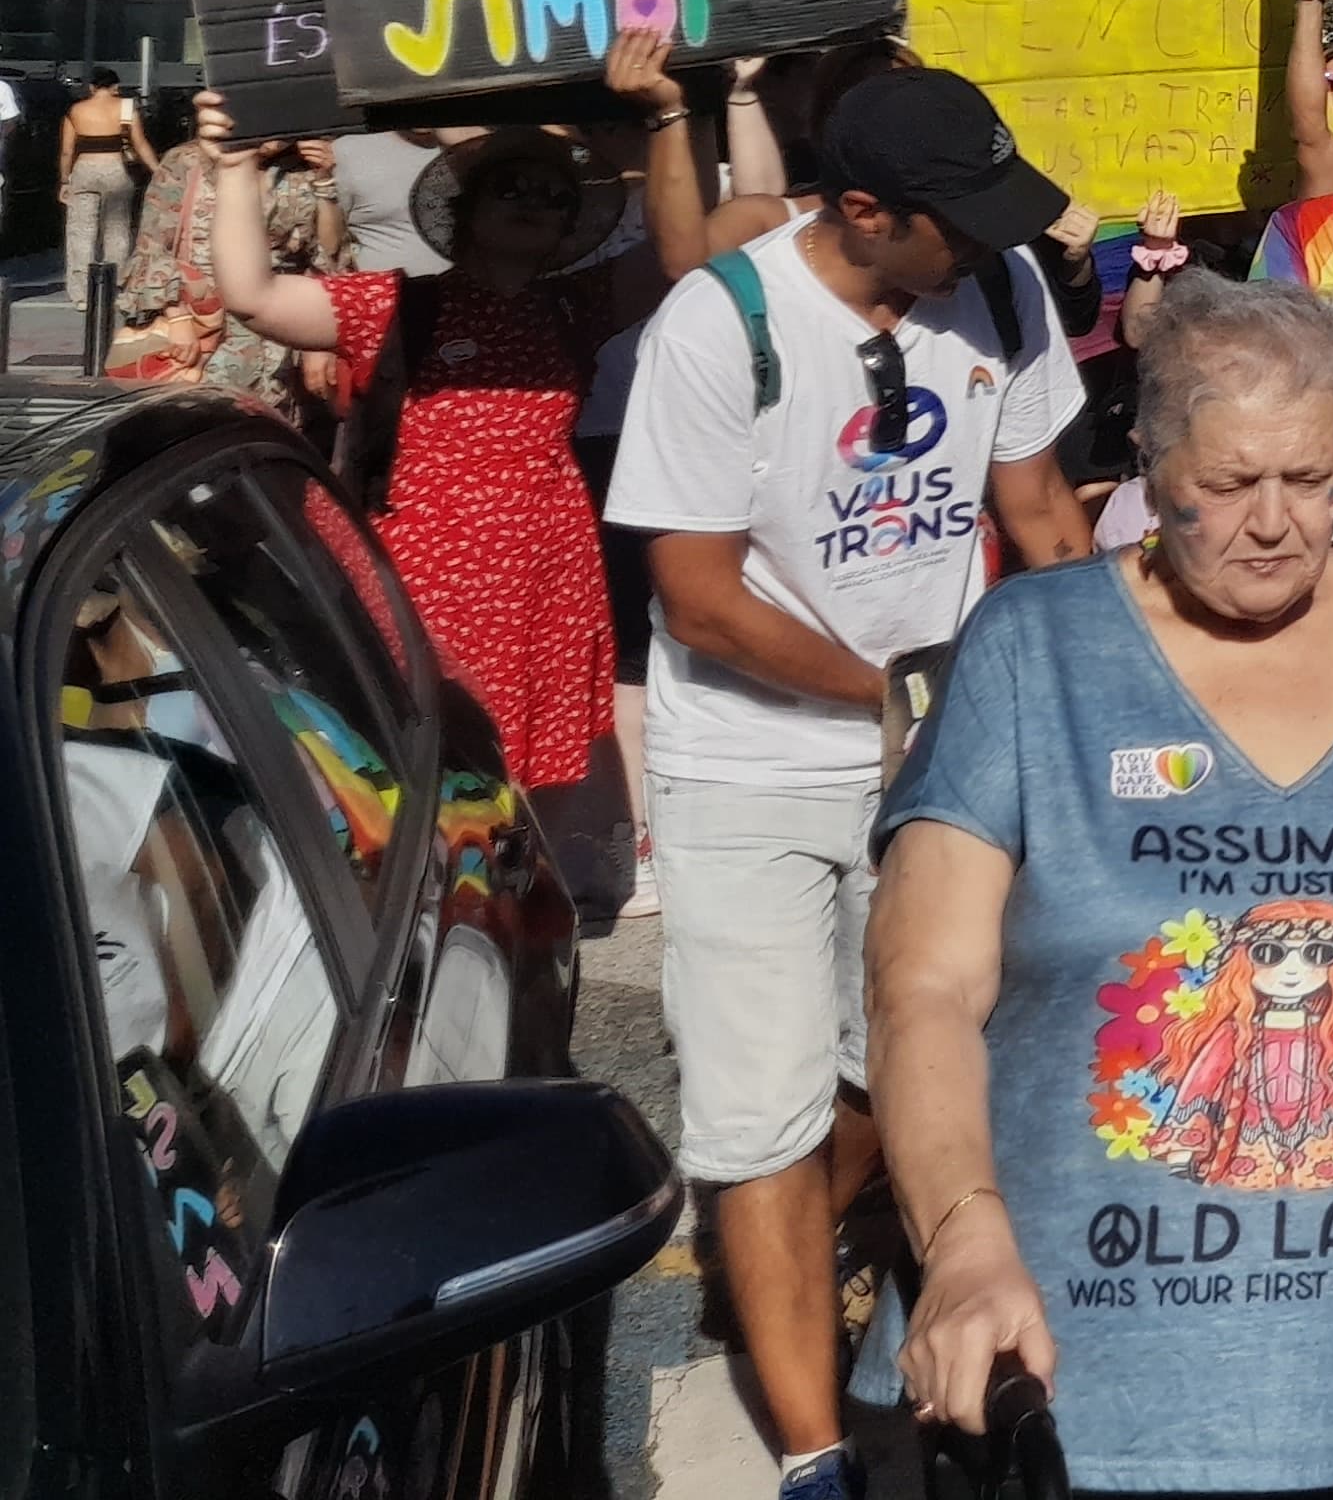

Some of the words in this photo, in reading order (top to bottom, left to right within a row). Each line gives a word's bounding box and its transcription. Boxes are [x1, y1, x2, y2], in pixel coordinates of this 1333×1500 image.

[1114, 752, 1152, 764] YOU
[1115, 763, 1153, 774] ARE
[1115, 774, 1158, 785] SAFE
[1116, 785, 1168, 796] HERE
[1179, 868, 1235, 896] I'M
[1087, 1202, 1241, 1269] OLD
[1066, 1276, 1137, 1309] WAS
[1153, 1275, 1234, 1307] YOUR
[1245, 1270, 1329, 1303] FIRST
